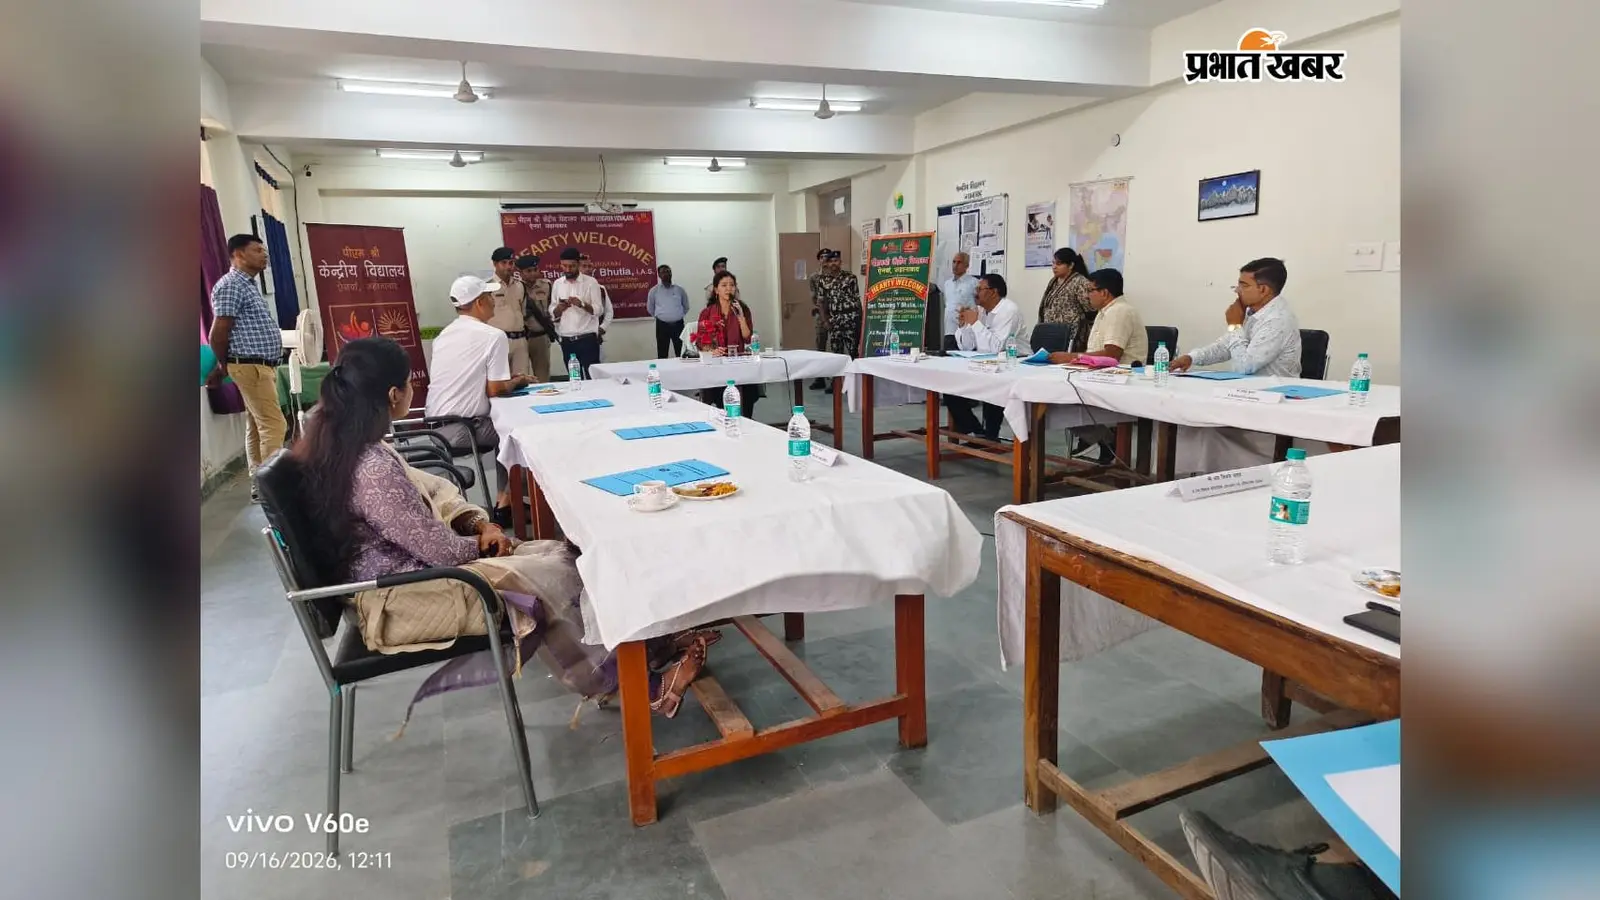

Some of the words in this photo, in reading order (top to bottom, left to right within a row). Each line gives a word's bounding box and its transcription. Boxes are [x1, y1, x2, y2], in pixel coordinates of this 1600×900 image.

[514, 232, 573, 260] EARTY
[572, 231, 654, 266] WELCOME
[317, 260, 358, 279] केन्द्रीय
[364, 260, 406, 278] विद्यालय
[895, 278, 925, 294] WELCOME
